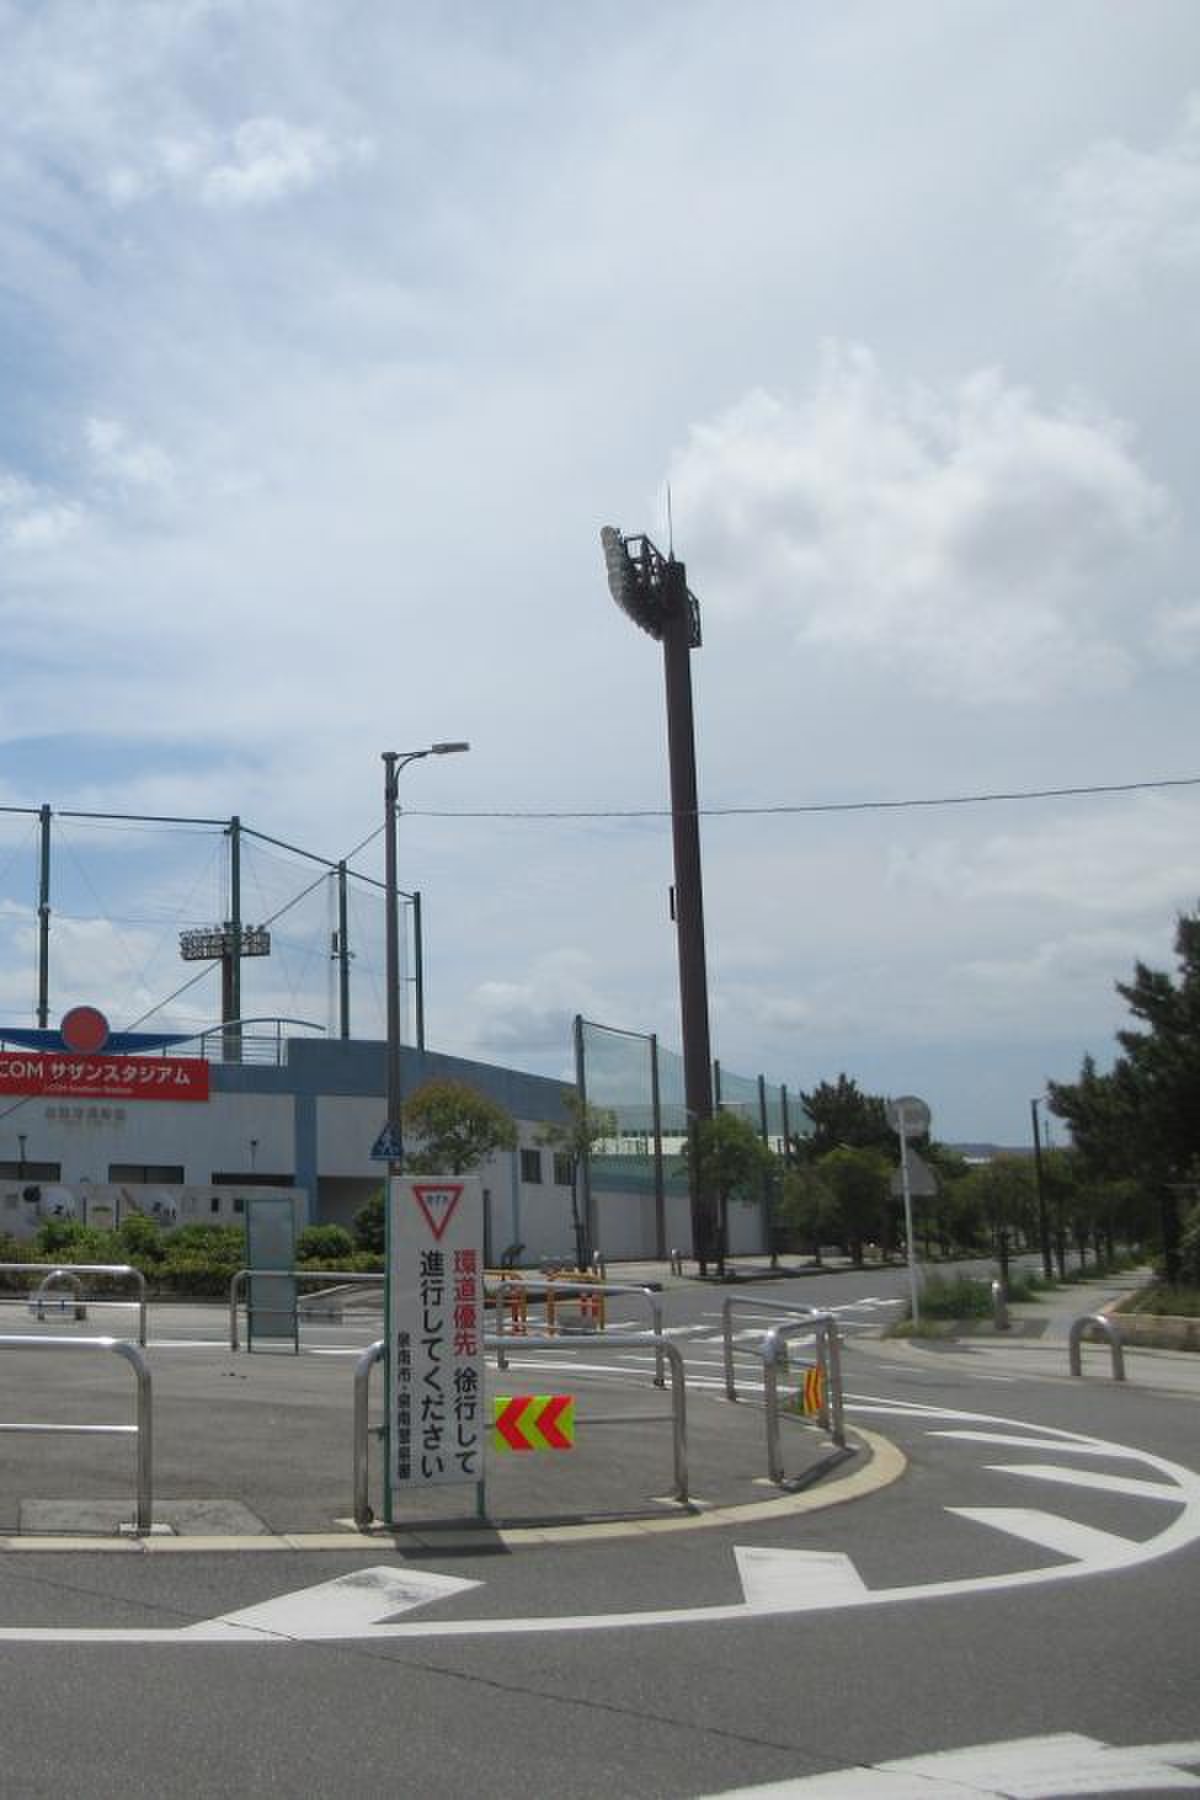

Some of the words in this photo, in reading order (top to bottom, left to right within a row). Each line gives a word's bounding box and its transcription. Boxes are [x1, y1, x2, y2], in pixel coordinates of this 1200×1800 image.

[51, 1063, 190, 1084] サザンスタジアム
[420, 1250, 445, 1478] 進行してください
[453, 1367, 478, 1474] 徐行して
